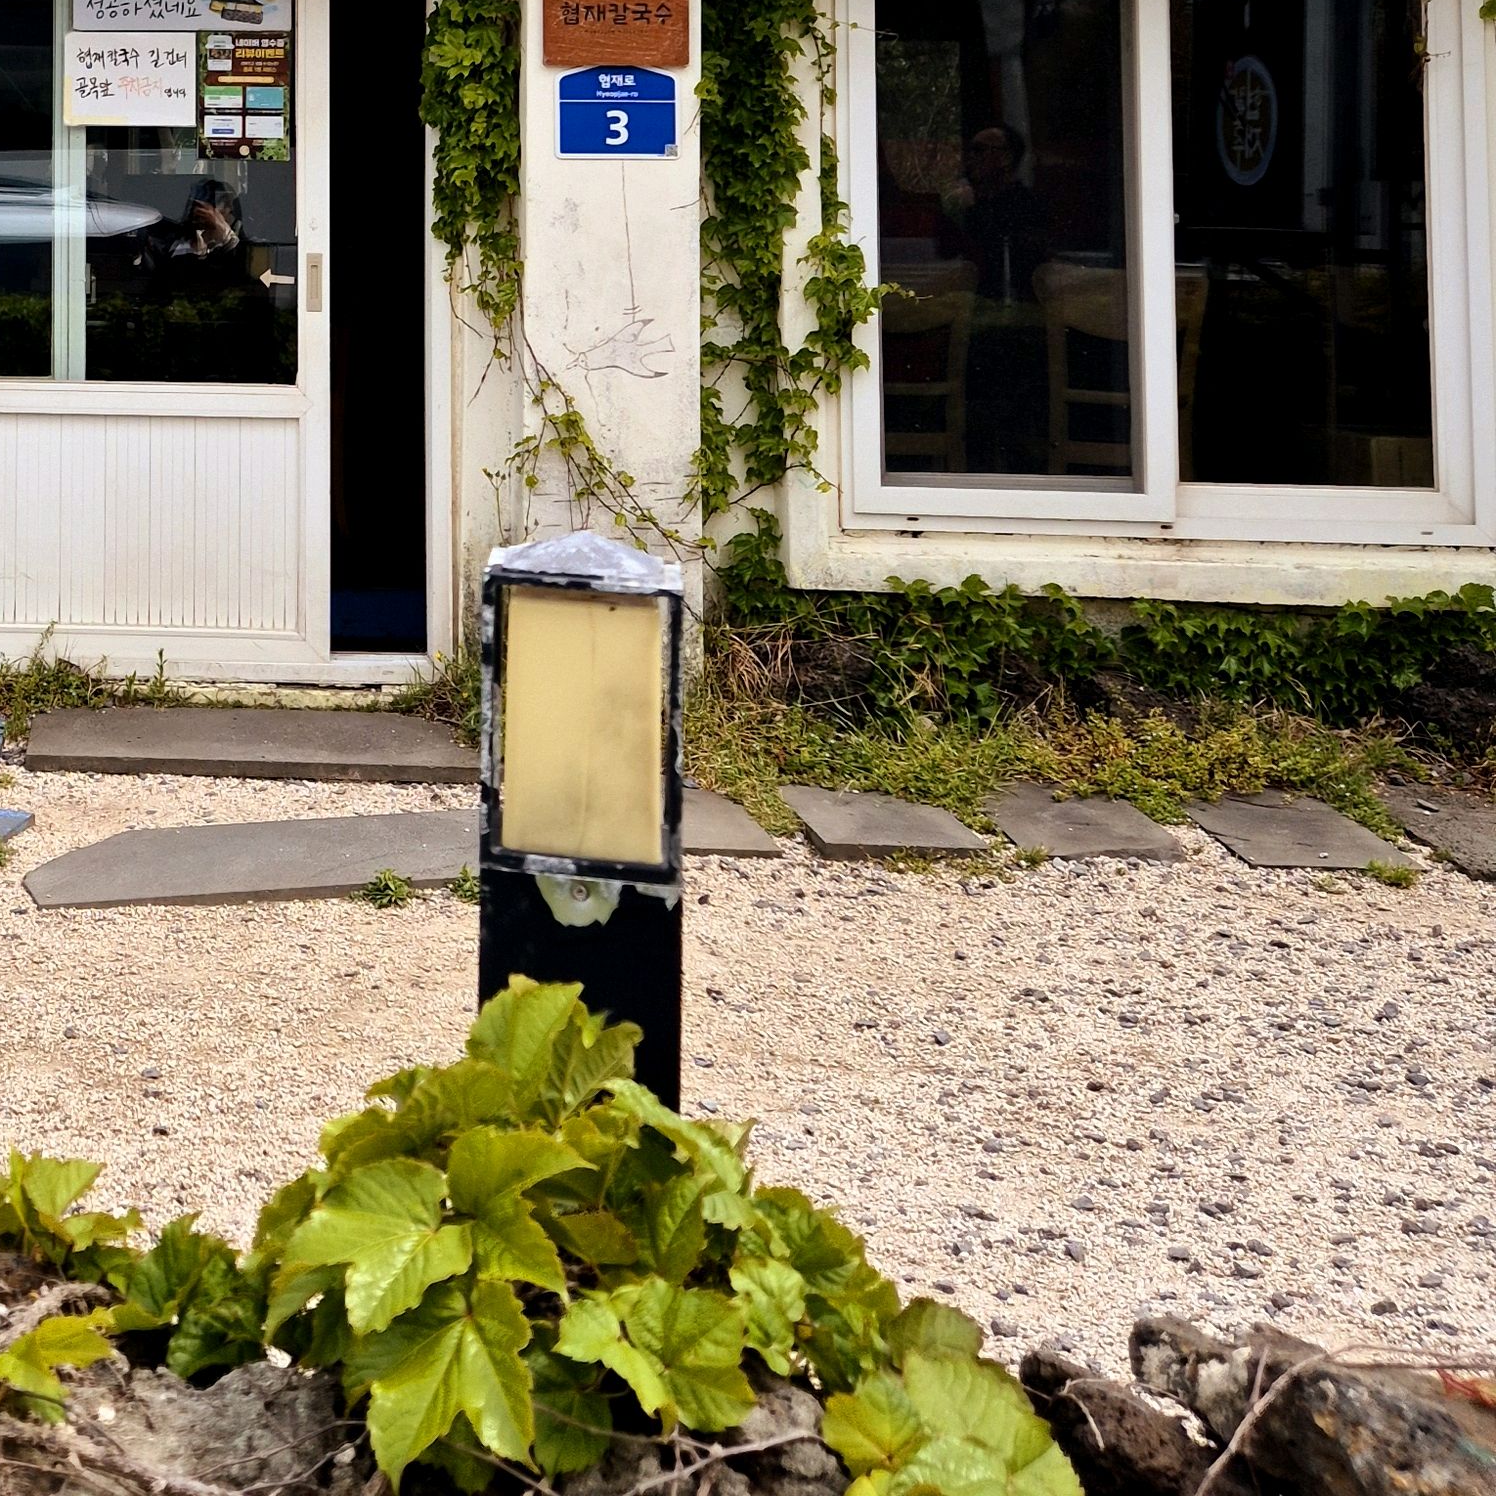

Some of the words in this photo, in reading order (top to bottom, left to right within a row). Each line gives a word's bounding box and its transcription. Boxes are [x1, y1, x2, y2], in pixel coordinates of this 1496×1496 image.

[560, 2, 673, 26] 협재칼국수
[598, 73, 637, 89] 협재로
[605, 109, 630, 146] 3
